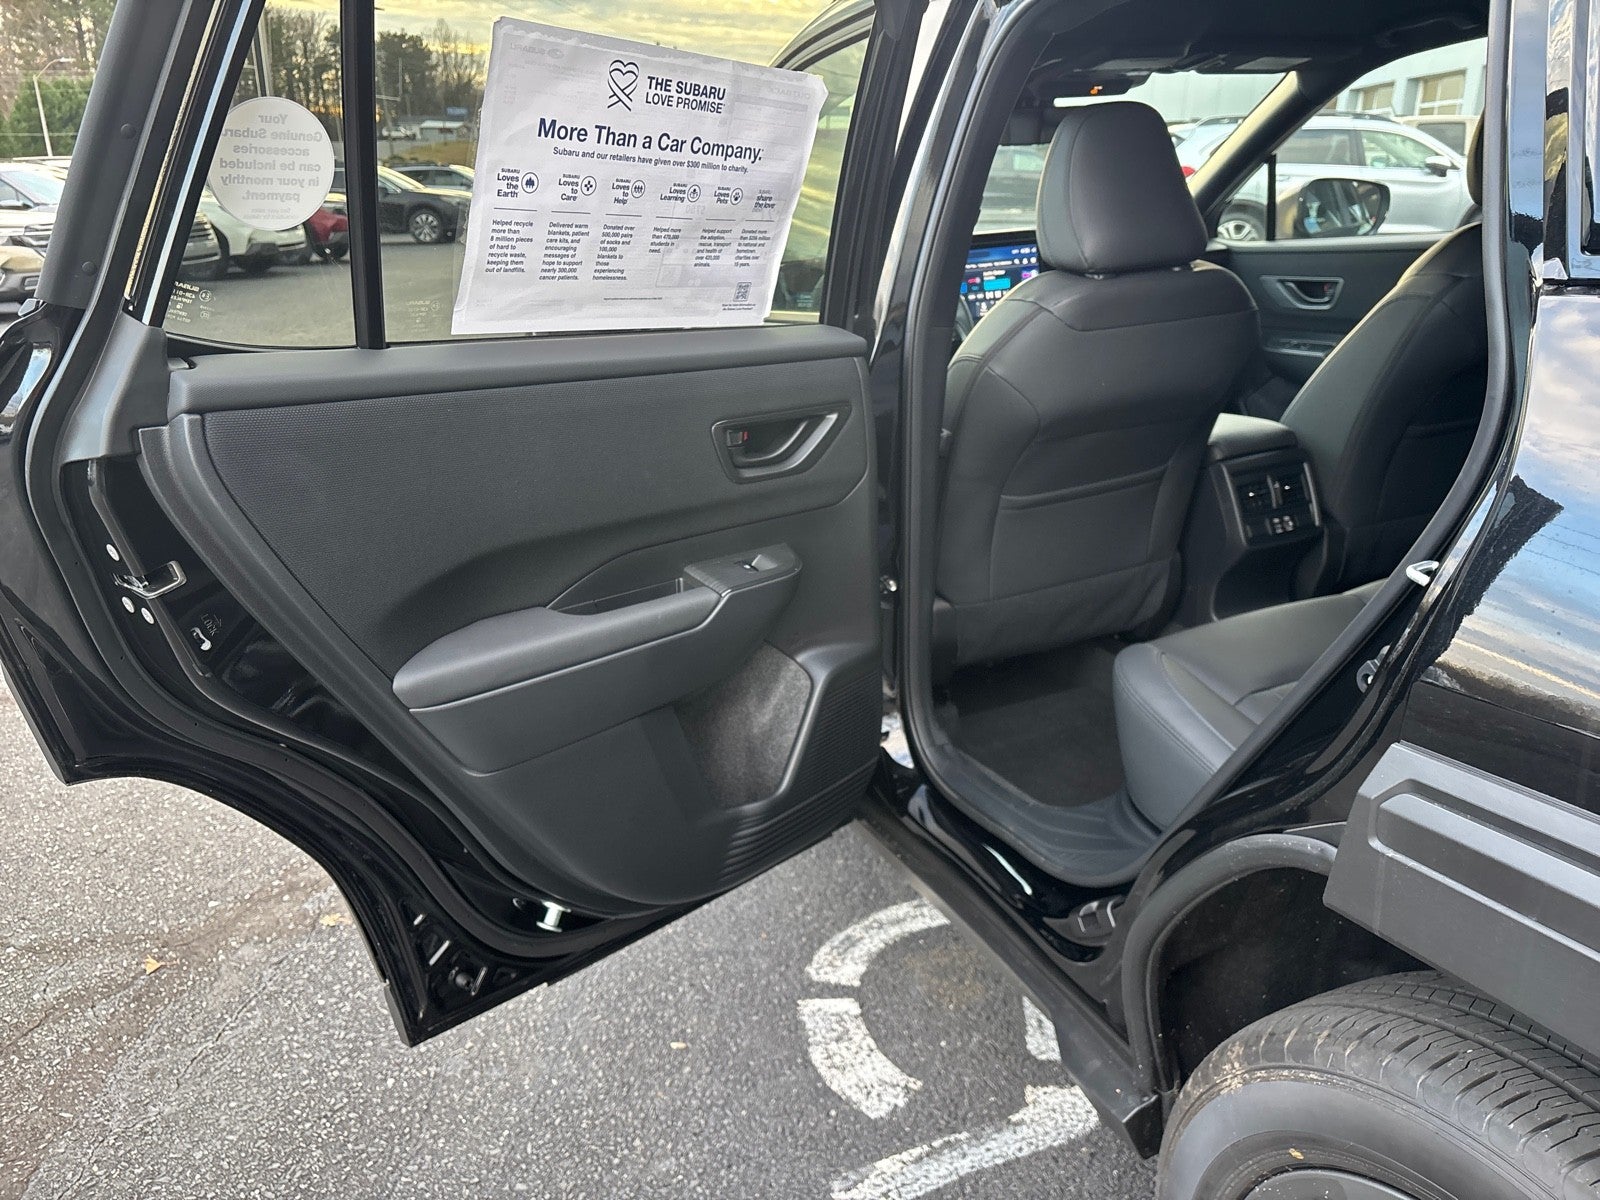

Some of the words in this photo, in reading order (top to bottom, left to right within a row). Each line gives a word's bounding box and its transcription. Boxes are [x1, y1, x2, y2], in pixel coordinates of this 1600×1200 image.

[647, 76, 672, 92] THE
[676, 80, 726, 100] SUBARU
[646, 92, 674, 107] LOVE
[676, 97, 723, 114] PROMISE
[537, 118, 588, 142] More
[594, 125, 637, 148] Than
[642, 135, 652, 149] a
[658, 133, 687, 153] Car
[691, 136, 762, 164] Company.
[553, 146, 579, 157] Subaru
[582, 150, 595, 159] and
[610, 154, 636, 163] retailers
[654, 158, 671, 166] given
[687, 160, 700, 169] $300
[728, 165, 748, 174] charity.
[497, 173, 519, 182] Loves
[558, 178, 579, 187] Loves
[497, 190, 518, 198] Earth
[614, 197, 628, 205] Help
[660, 194, 685, 203] Learning
[201, 614, 217, 636] LOCK
